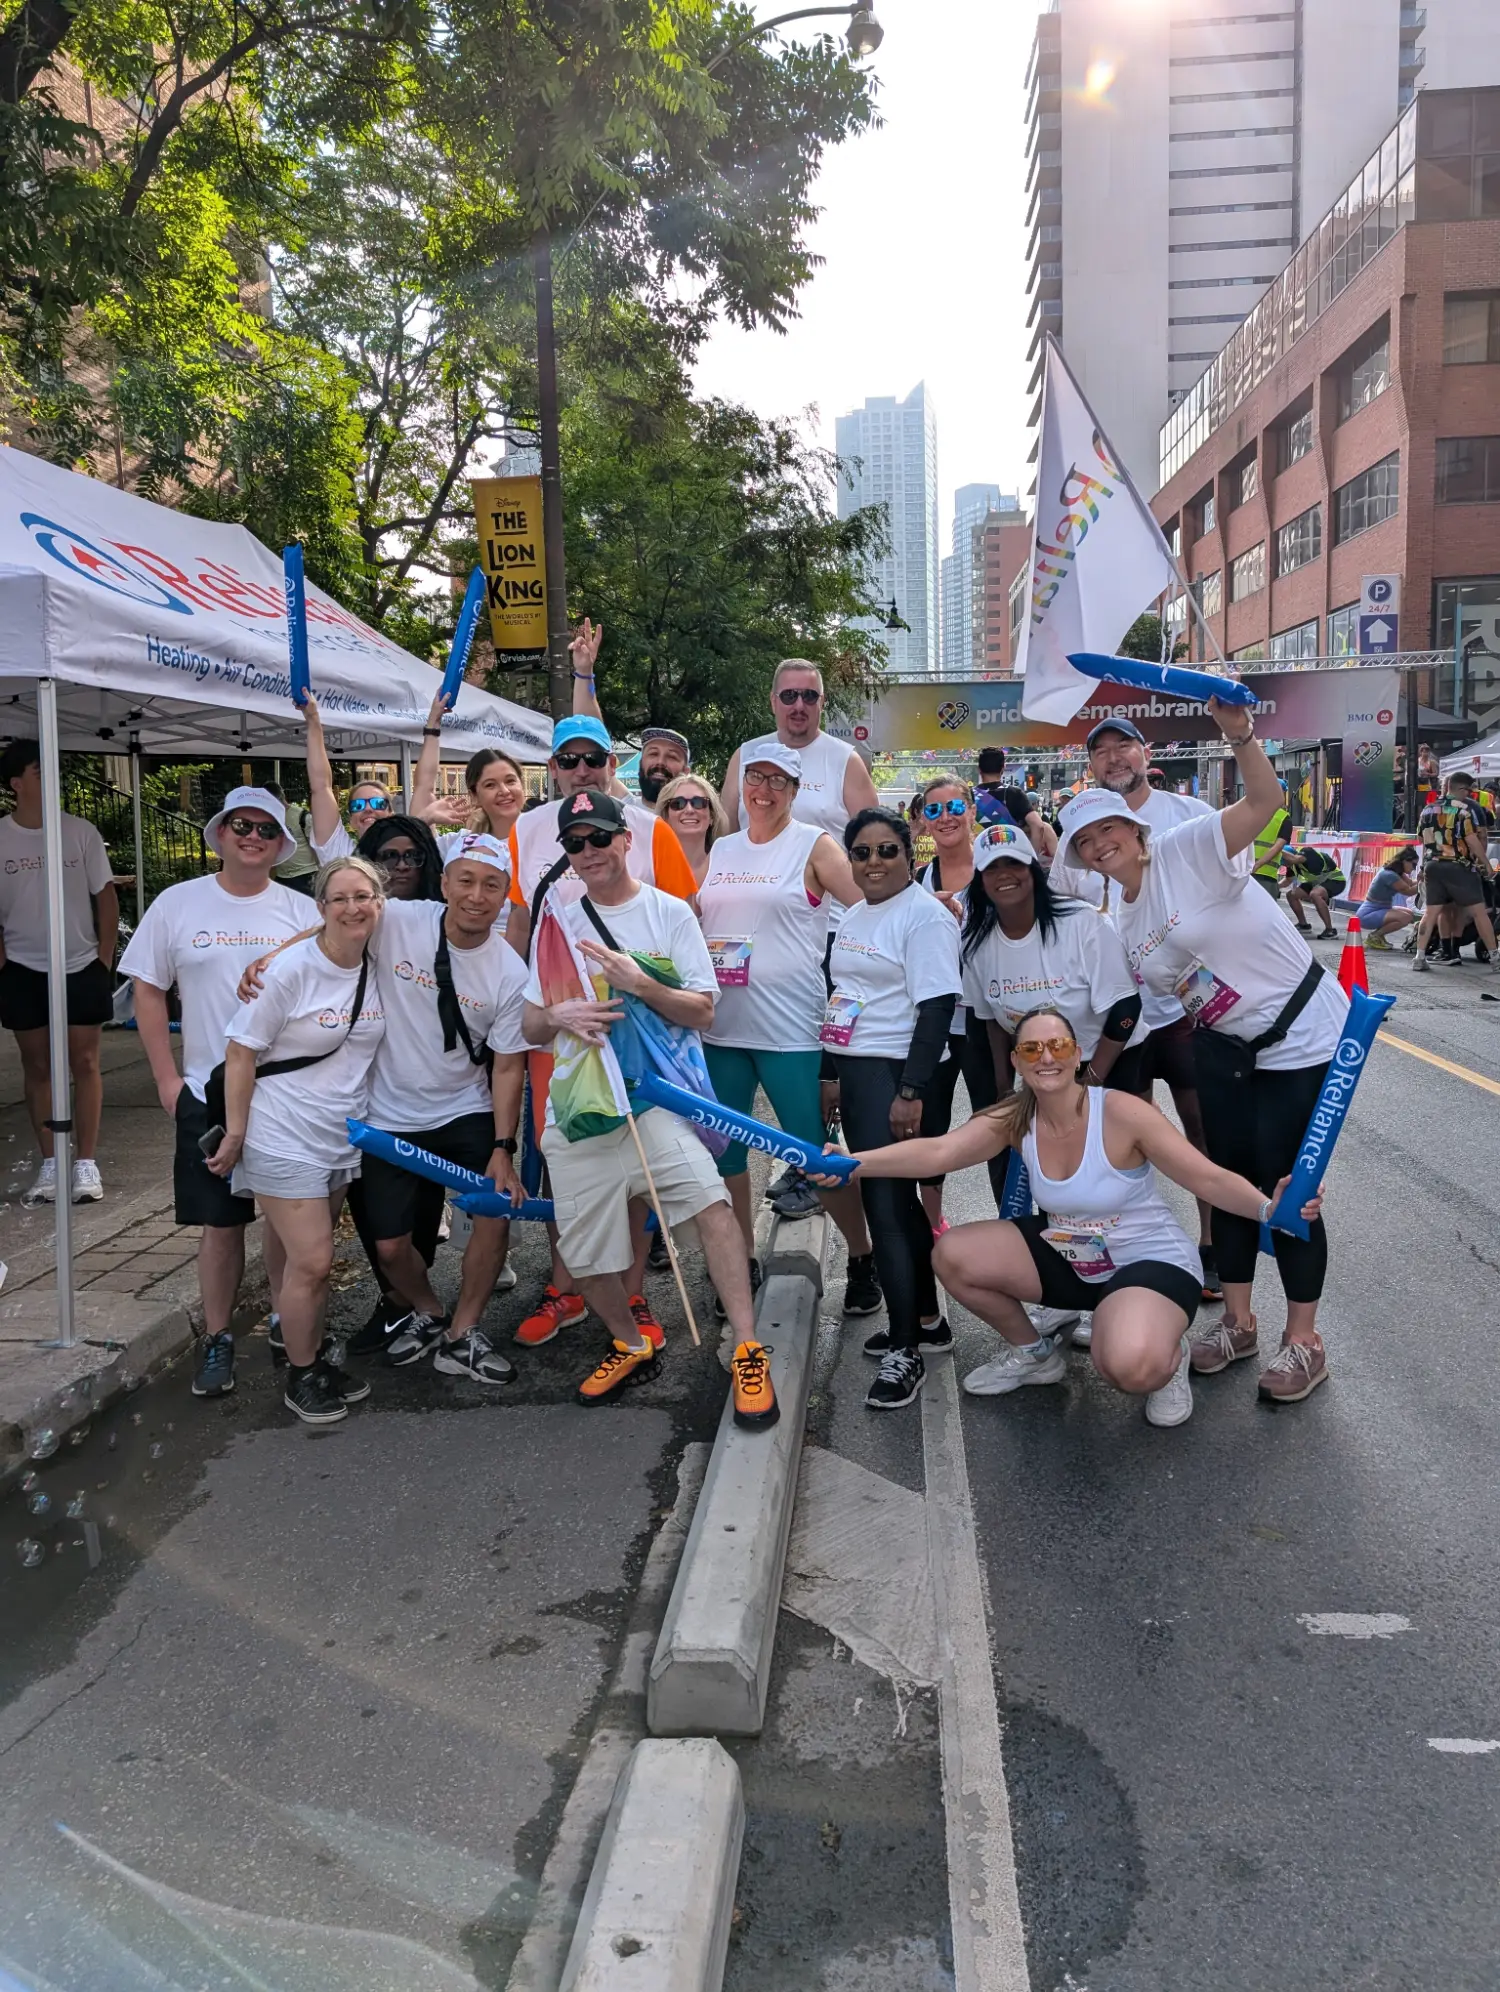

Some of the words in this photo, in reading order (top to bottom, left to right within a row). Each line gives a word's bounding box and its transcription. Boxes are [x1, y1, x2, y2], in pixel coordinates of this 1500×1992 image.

[491, 511, 527, 530] THE
[487, 540, 536, 571] LION
[487, 575, 543, 609] KING
[1374, 584, 1387, 599] P
[1368, 605, 1391, 613] 24/7
[146, 633, 211, 681] Heating
[219, 657, 242, 684] Air
[242, 663, 316, 699] Conditio
[321, 687, 343, 712] Hot
[509, 726, 525, 742] Smart
[525, 732, 540, 746] Home
[976, 700, 1029, 729] prid
[1077, 695, 1213, 721] emembranc
[1251, 699, 1276, 715] un
[1347, 713, 1374, 722] BMO
[828, 728, 852, 737] BMO
[1002, 775, 1020, 787] ids
[913, 843, 935, 852] YOUR
[20, 856, 79, 870] Relice
[722, 872, 779, 884] Reliance
[1137, 912, 1181, 960] Reliance
[712, 956, 725, 967] 56
[1002, 976, 1063, 994] Reliance
[1299, 1068, 1356, 1170] Reliance
[692, 1108, 780, 1157] Reliance
[416, 1146, 486, 1187] Reliance
[1006, 1164, 1029, 1219] elianc
[1061, 1249, 1077, 1260] 78
